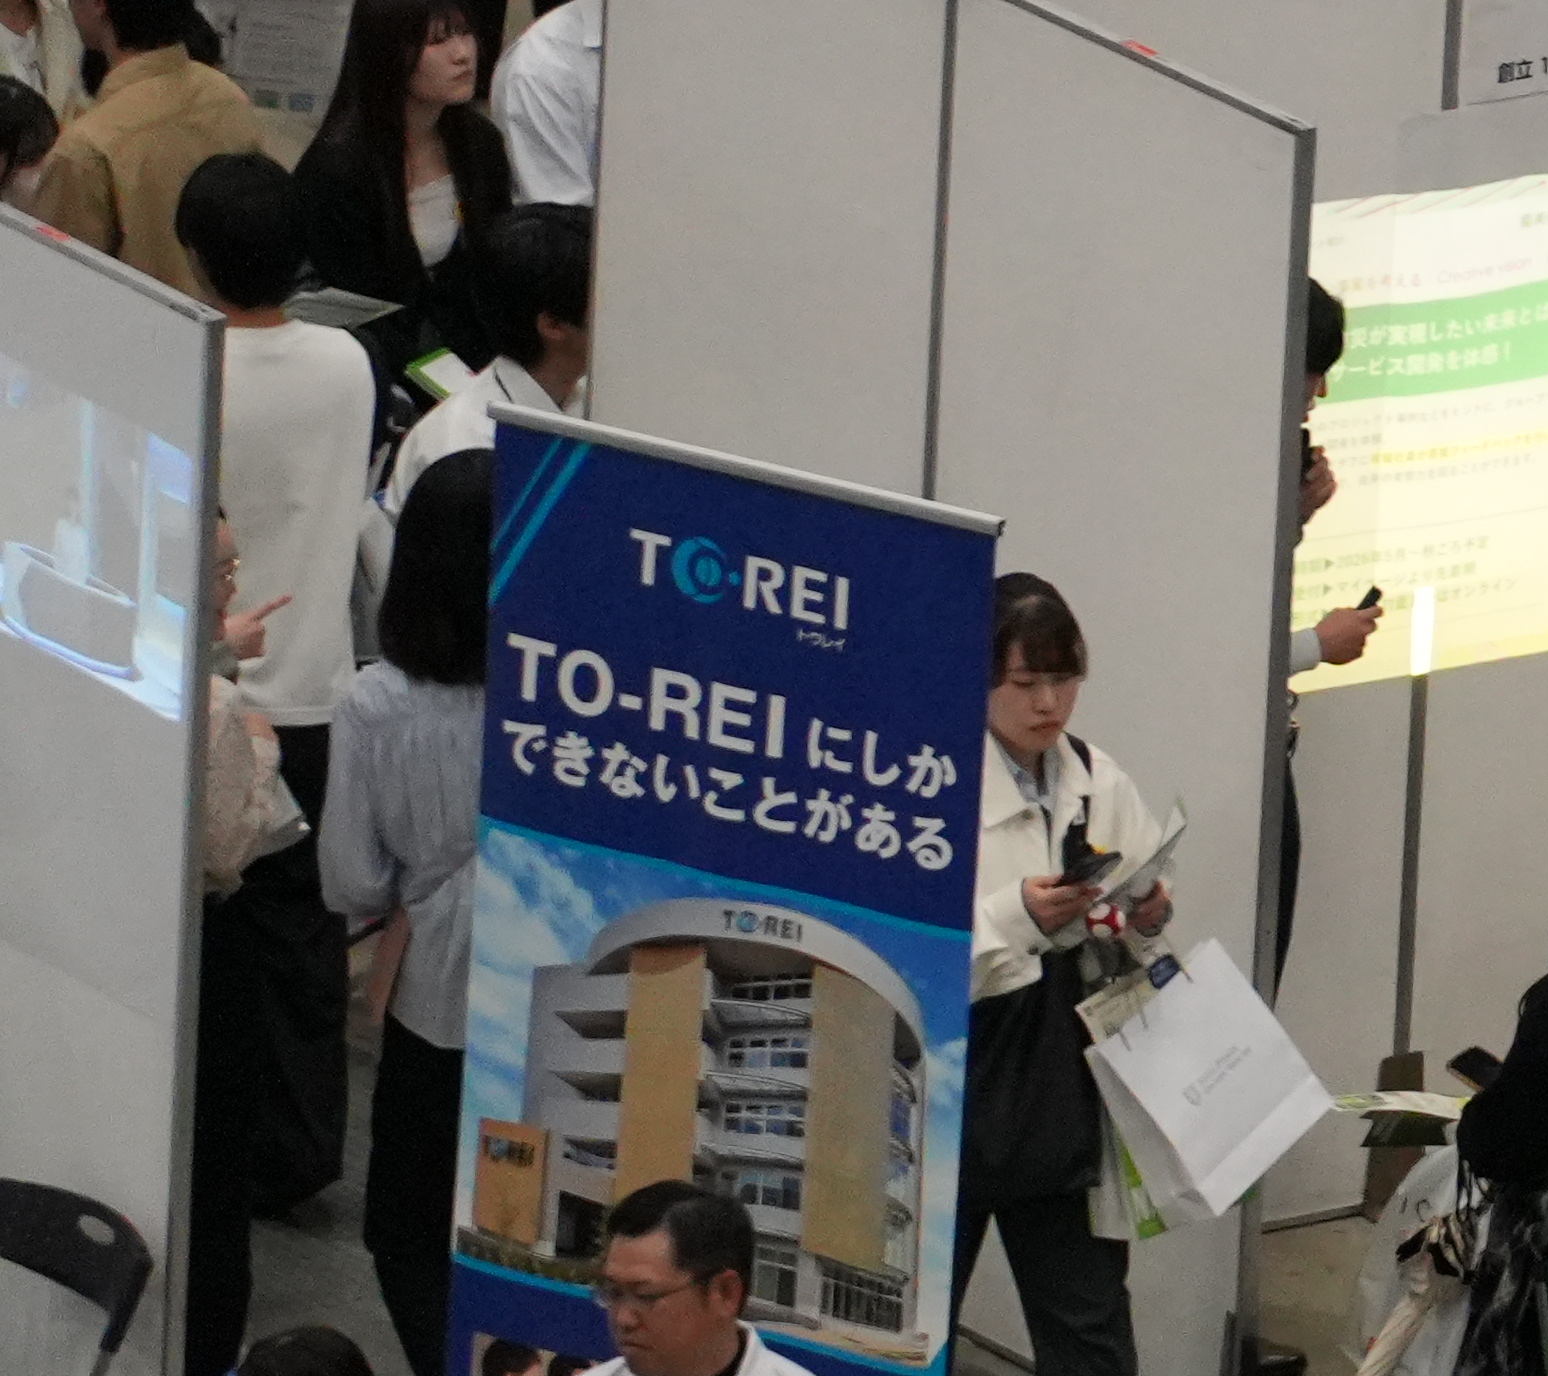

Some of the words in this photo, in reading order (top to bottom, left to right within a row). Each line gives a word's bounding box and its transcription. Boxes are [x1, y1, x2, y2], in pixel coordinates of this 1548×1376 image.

[1496, 60, 1534, 85] 創立
[503, 632, 787, 761] TO-REI
[806, 720, 958, 801] にしか
[501, 719, 955, 871] できないことがある
